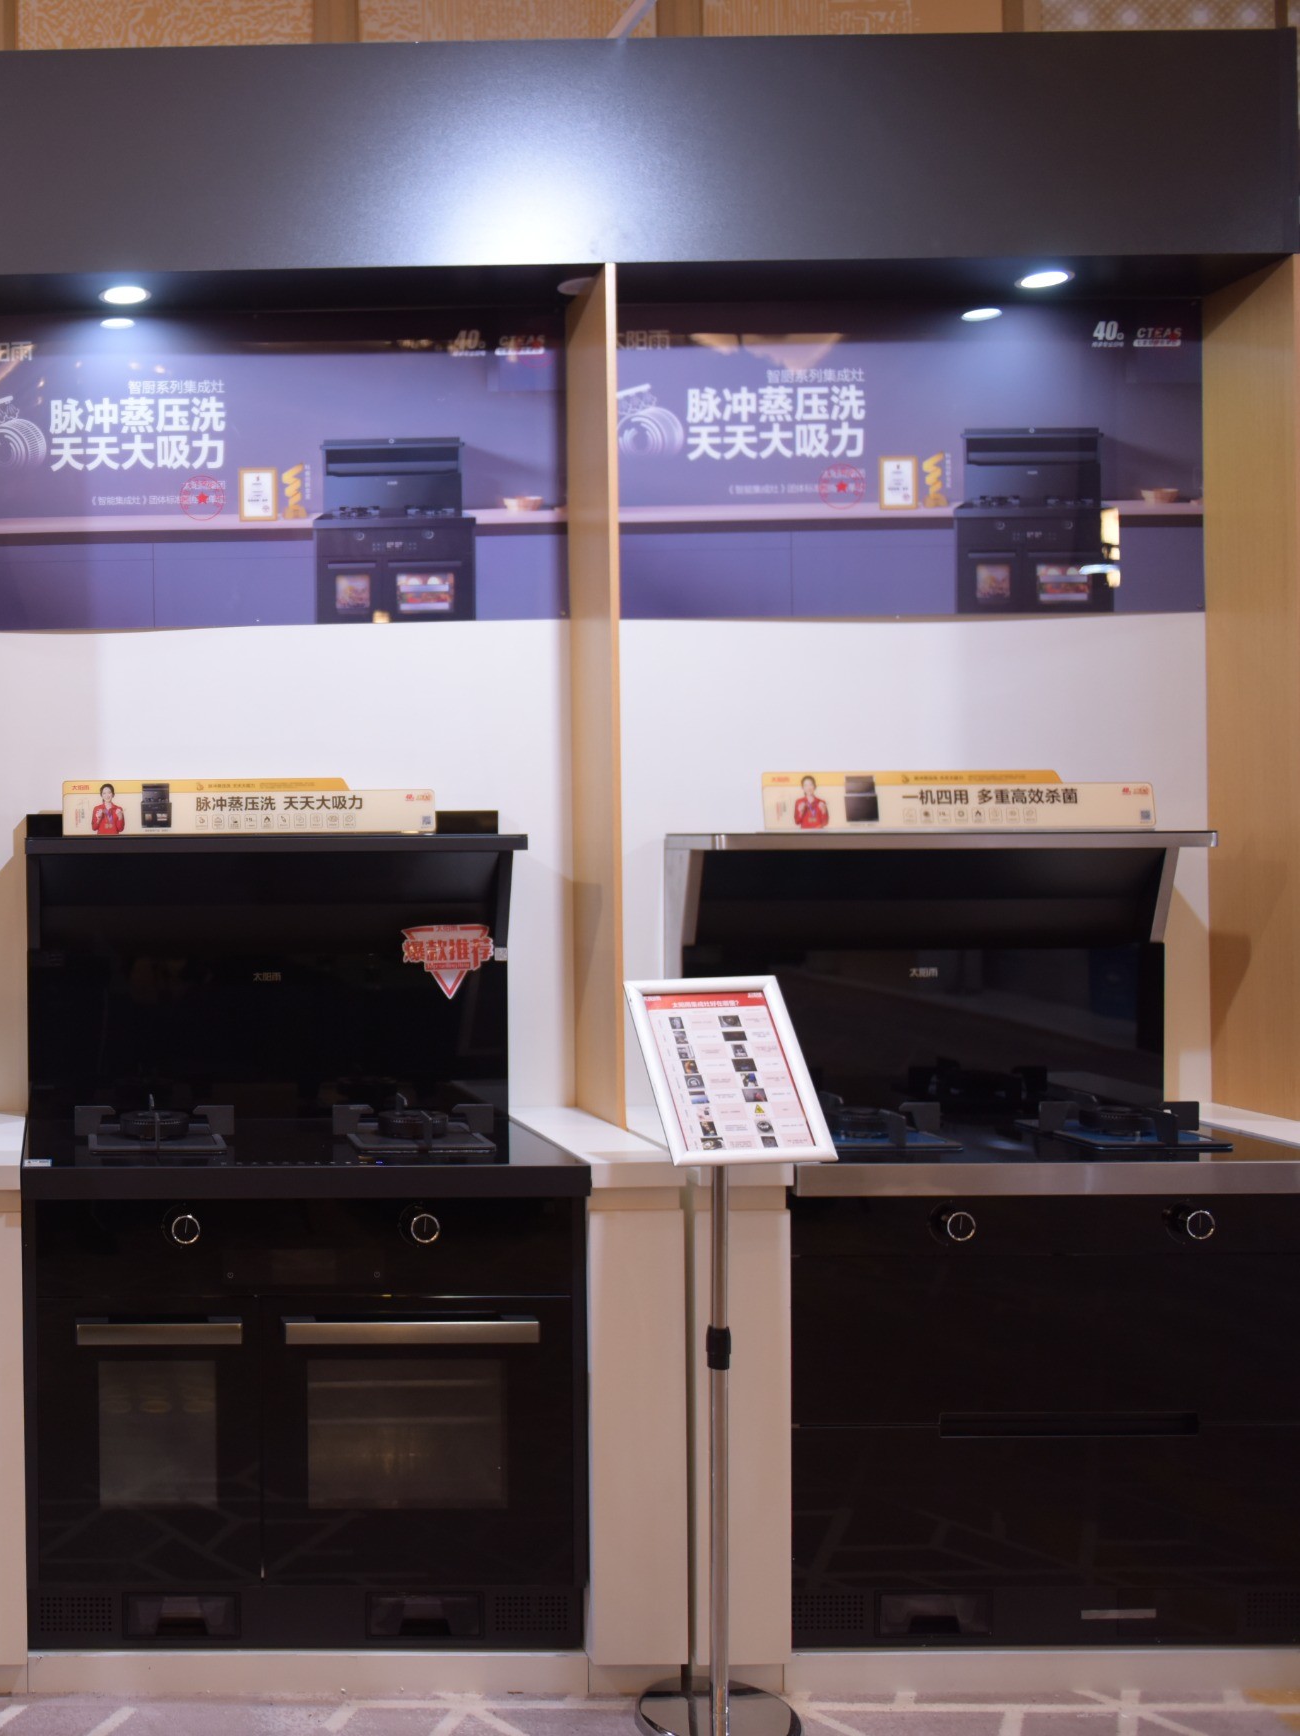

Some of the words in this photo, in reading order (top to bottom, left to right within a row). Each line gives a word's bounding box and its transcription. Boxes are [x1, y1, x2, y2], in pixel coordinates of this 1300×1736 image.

[766, 368, 865, 383] 智厨系列集成灶
[128, 379, 225, 394] 智厨系列集成灶
[686, 384, 866, 423] 脉冲蒸压洗
[50, 396, 226, 434] 脉冲蒸压洗
[686, 422, 865, 461] 天天大吸力
[50, 434, 225, 472] 天天大吸力
[195, 796, 276, 812] 脉冲蒸压洗
[283, 794, 364, 811] 天天大吸力
[901, 788, 969, 806] 一机四用
[977, 788, 1078, 805] 多重高效杀菌
[405, 938, 492, 967] 爆款推荐
[253, 972, 281, 982] 太阳雨
[909, 967, 938, 978] 太阳雨
